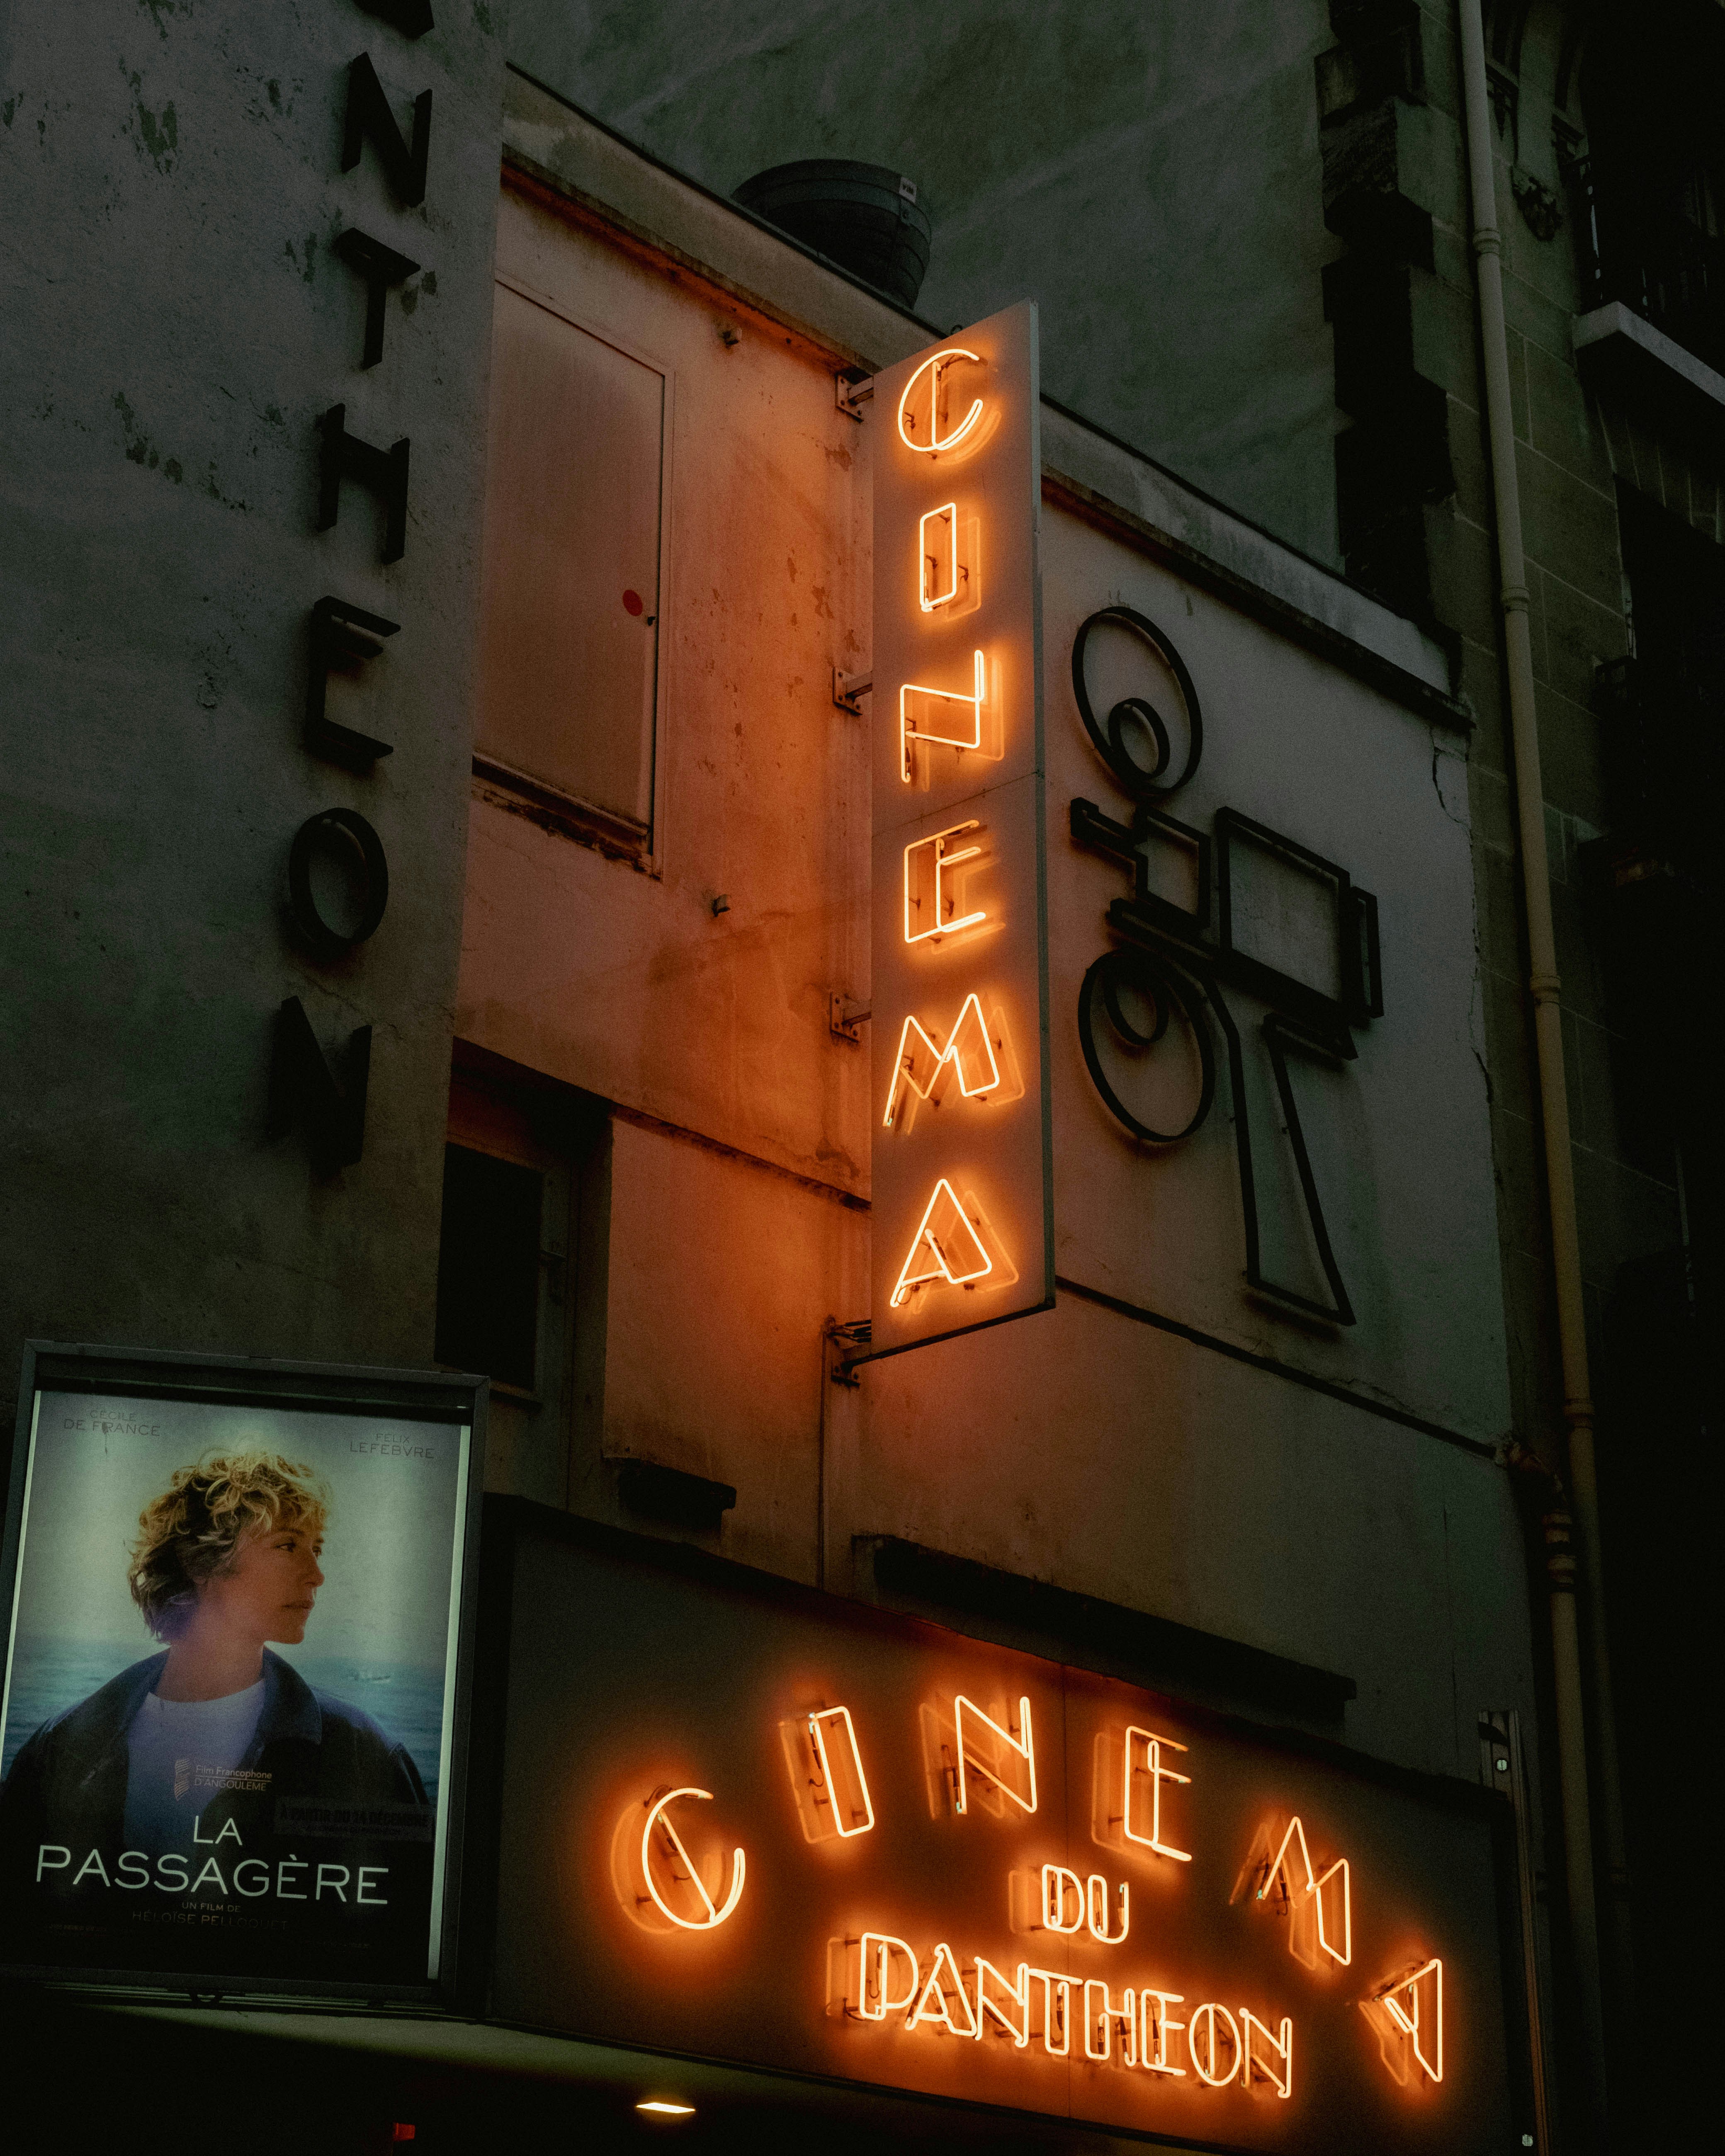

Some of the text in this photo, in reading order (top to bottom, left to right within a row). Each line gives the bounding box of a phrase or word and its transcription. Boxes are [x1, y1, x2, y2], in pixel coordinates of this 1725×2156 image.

[882, 349, 1000, 1308] CINEMA
[64, 1418, 161, 1437] DE FRANCE
[350, 1441, 435, 1459] LEFEBVRE
[196, 1764, 272, 1780] Film Francophone
[193, 1815, 243, 1846] LA
[36, 1844, 389, 1905] PASSAGÈRE
[641, 1694, 1443, 2082] CINEMA
[132, 1908, 288, 1931] HÉLOÏSE PELLOQUET
[181, 1901, 242, 1913] UN FILM DE
[1042, 1864, 1129, 1944] DU
[860, 1931, 1293, 2098] PANTHEON
